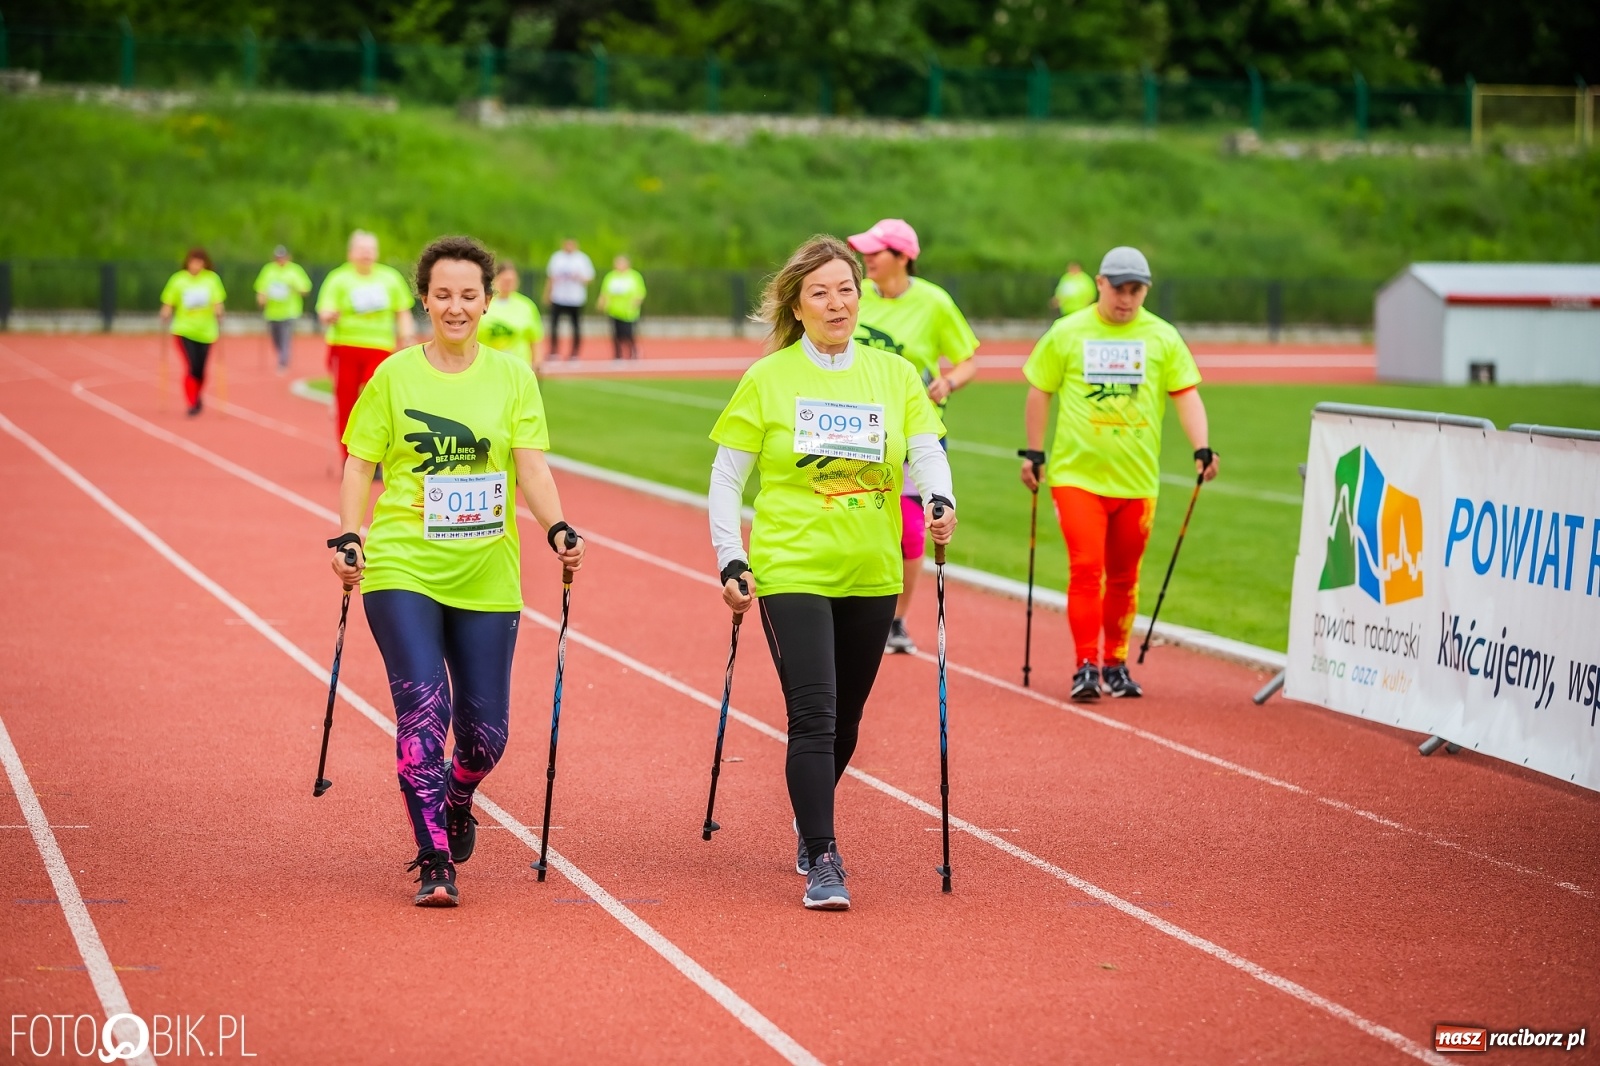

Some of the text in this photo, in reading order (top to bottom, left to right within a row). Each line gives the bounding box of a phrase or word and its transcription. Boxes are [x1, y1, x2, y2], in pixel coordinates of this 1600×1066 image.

[1100, 347, 1128, 362] 094
[818, 414, 862, 434] 099
[869, 413, 879, 424] R
[433, 436, 457, 455] VI
[435, 455, 448, 463] BEZ
[494, 483, 502, 494] R
[448, 490, 489, 513] 011
[1444, 497, 1585, 592] POWIAT
[1313, 607, 1356, 646] powiat
